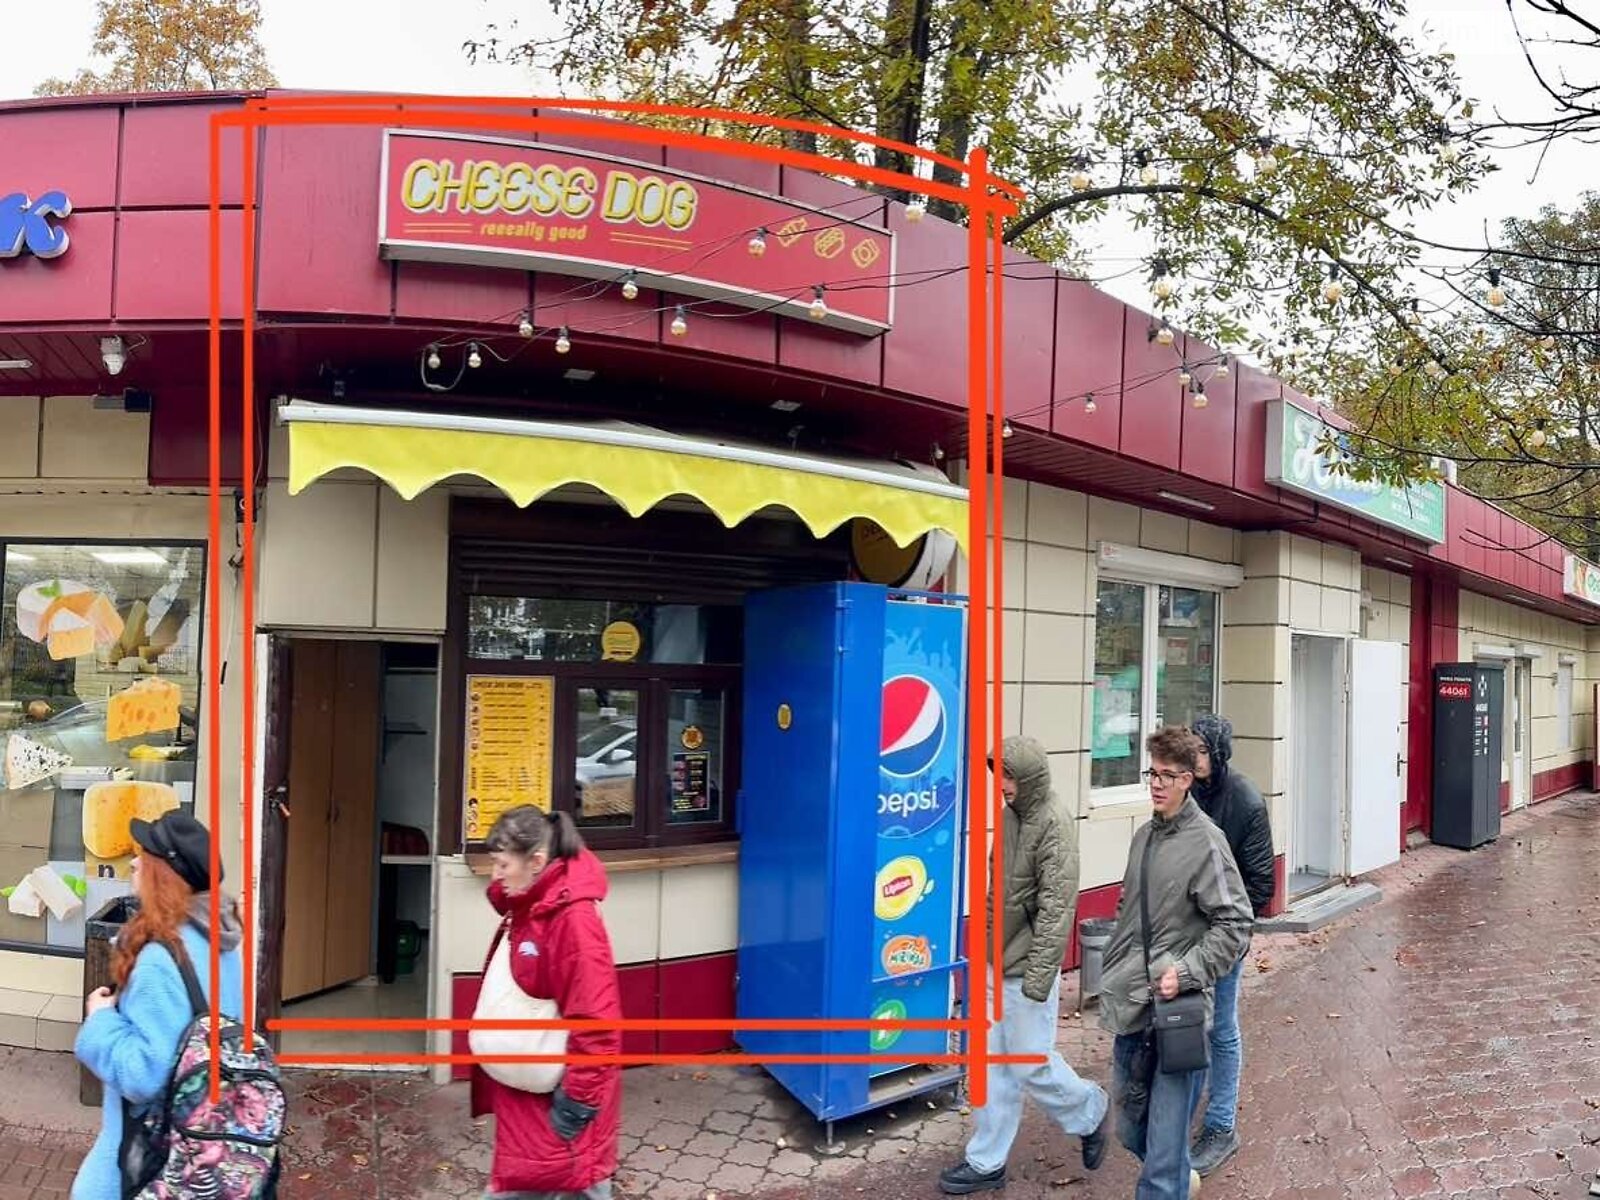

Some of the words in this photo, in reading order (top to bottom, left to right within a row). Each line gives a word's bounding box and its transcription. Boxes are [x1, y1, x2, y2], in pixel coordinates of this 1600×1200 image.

[402, 158, 598, 218] CHEESE
[600, 169, 698, 231] DOG
[548, 223, 588, 242] good
[1440, 686, 1468, 695] 44061
